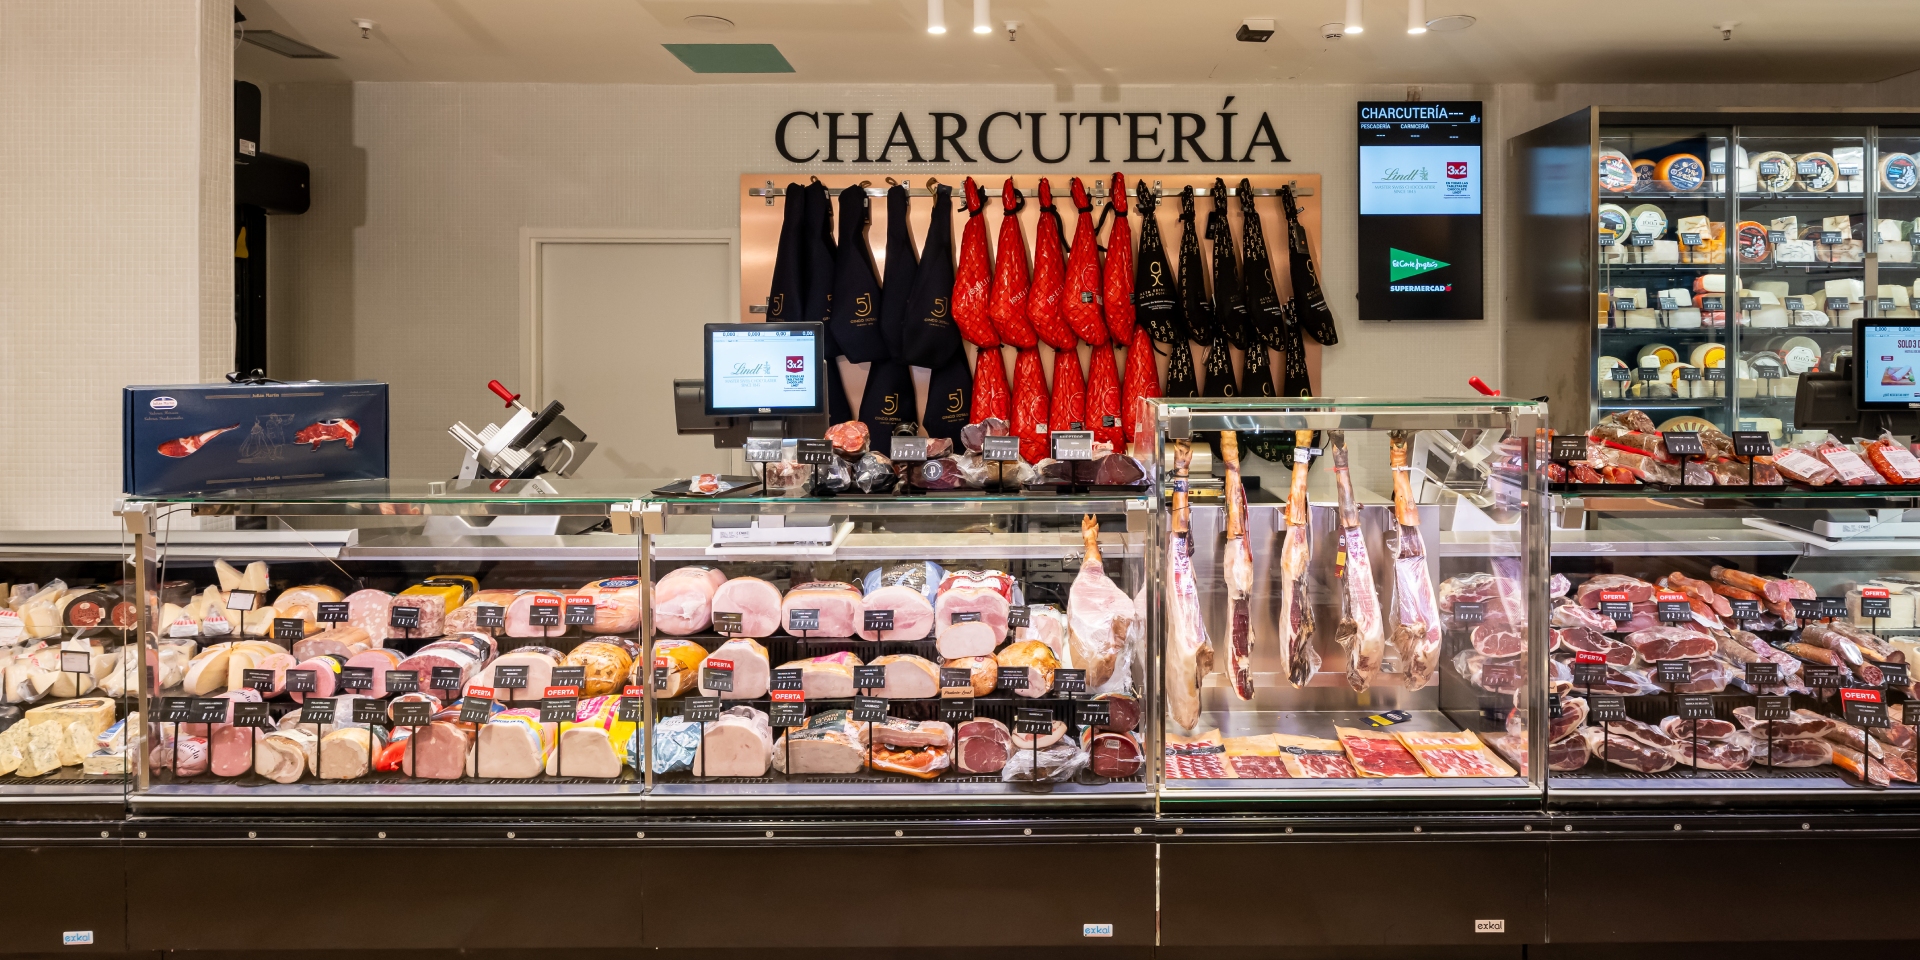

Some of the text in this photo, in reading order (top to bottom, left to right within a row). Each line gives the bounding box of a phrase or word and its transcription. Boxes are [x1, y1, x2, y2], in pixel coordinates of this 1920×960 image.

[1361, 104, 1448, 119] CHARCUTERÍA
[774, 96, 1292, 163] CHARCUTERÍA
[1381, 168, 1419, 180] Lindt
[1447, 165, 1467, 175] 3x2
[1897, 339, 1917, 349] SOLO 3
[730, 362, 763, 376] Lindt
[786, 359, 804, 369] 3x2
[1578, 653, 1603, 662] OFERTA
[709, 661, 732, 669] OFERTA
[469, 688, 491, 697] OFERTA
[1844, 691, 1877, 700] OFERTA
[1084, 925, 1111, 934] exkal
[1477, 920, 1503, 930] exkal
[64, 932, 91, 942] exkal
